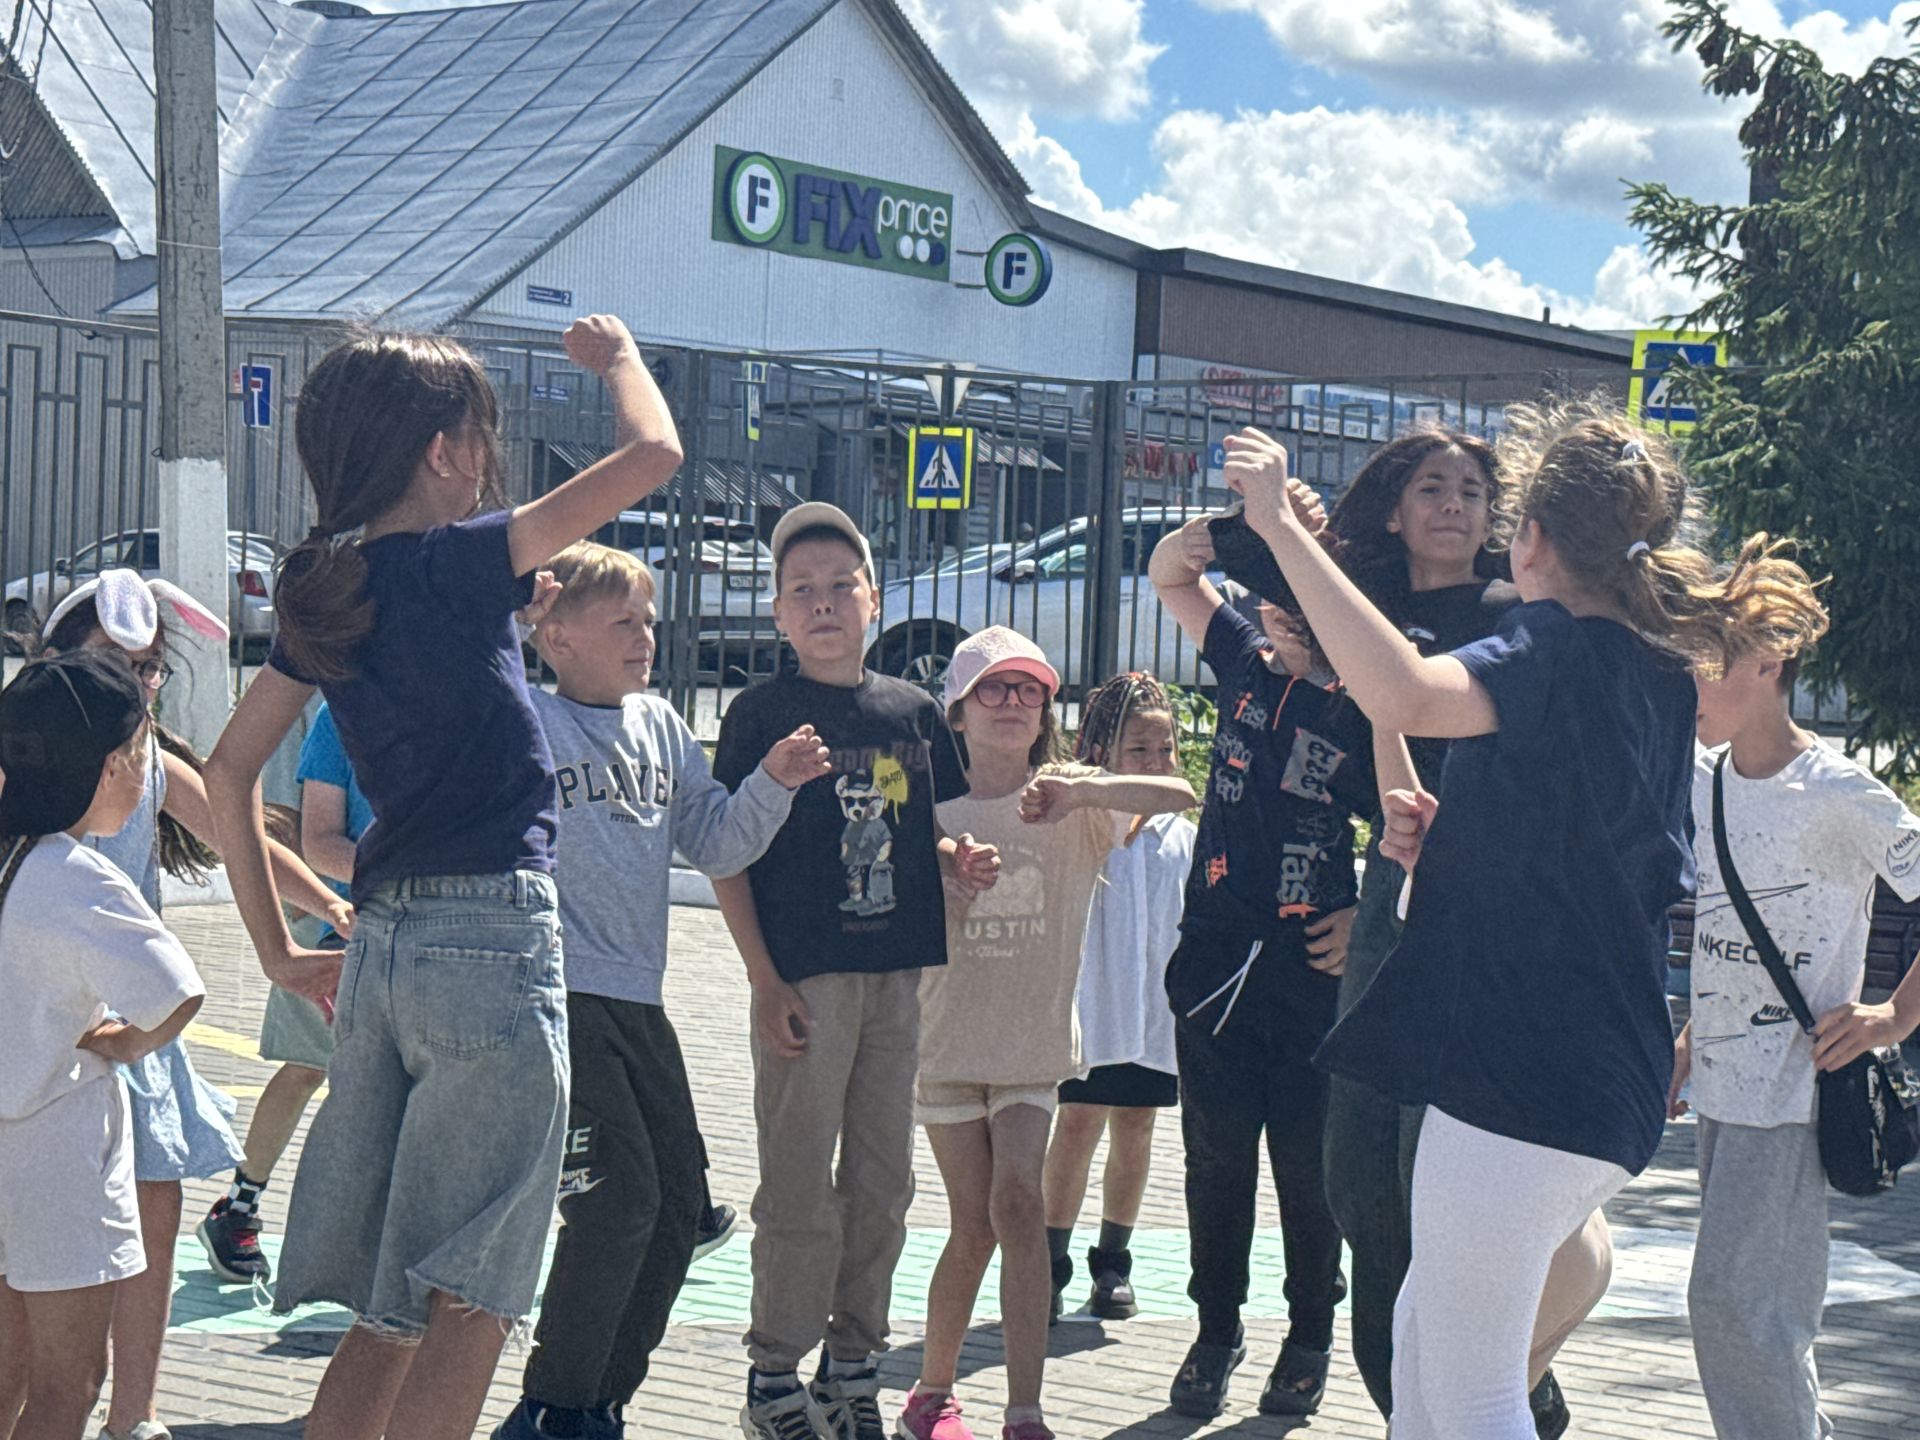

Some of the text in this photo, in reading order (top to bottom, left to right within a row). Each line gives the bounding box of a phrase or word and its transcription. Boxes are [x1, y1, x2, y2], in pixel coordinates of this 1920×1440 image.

[746, 173, 948, 259] F FIX price
[1002, 251, 1027, 290] F
[562, 291, 570, 305] 2
[964, 917, 1047, 940] USTIN
